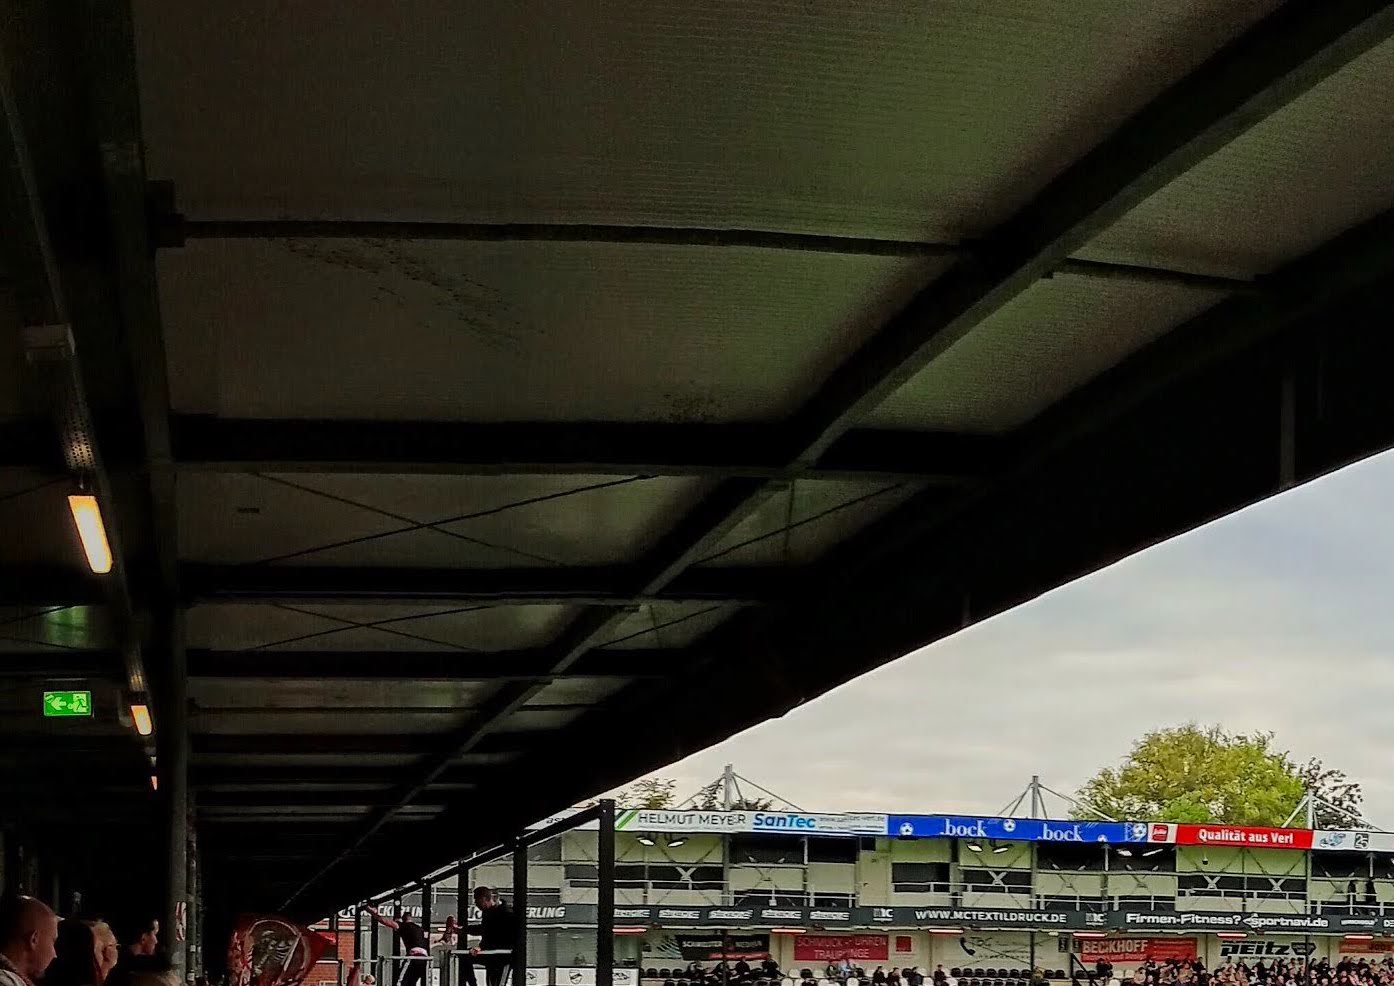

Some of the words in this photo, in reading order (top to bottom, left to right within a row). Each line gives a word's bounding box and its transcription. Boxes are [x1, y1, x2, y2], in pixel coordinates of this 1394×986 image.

[638, 812, 694, 825] HELMUT
[753, 813, 816, 829] SanTec
[1198, 828, 1246, 843] Qualität
[1248, 832, 1268, 843] aus
[1271, 832, 1293, 844] Verl
[915, 910, 1067, 923] WWW.MCTEXTILDRUCK.DE
[1125, 913, 1242, 925] Firmen-Fitness?
